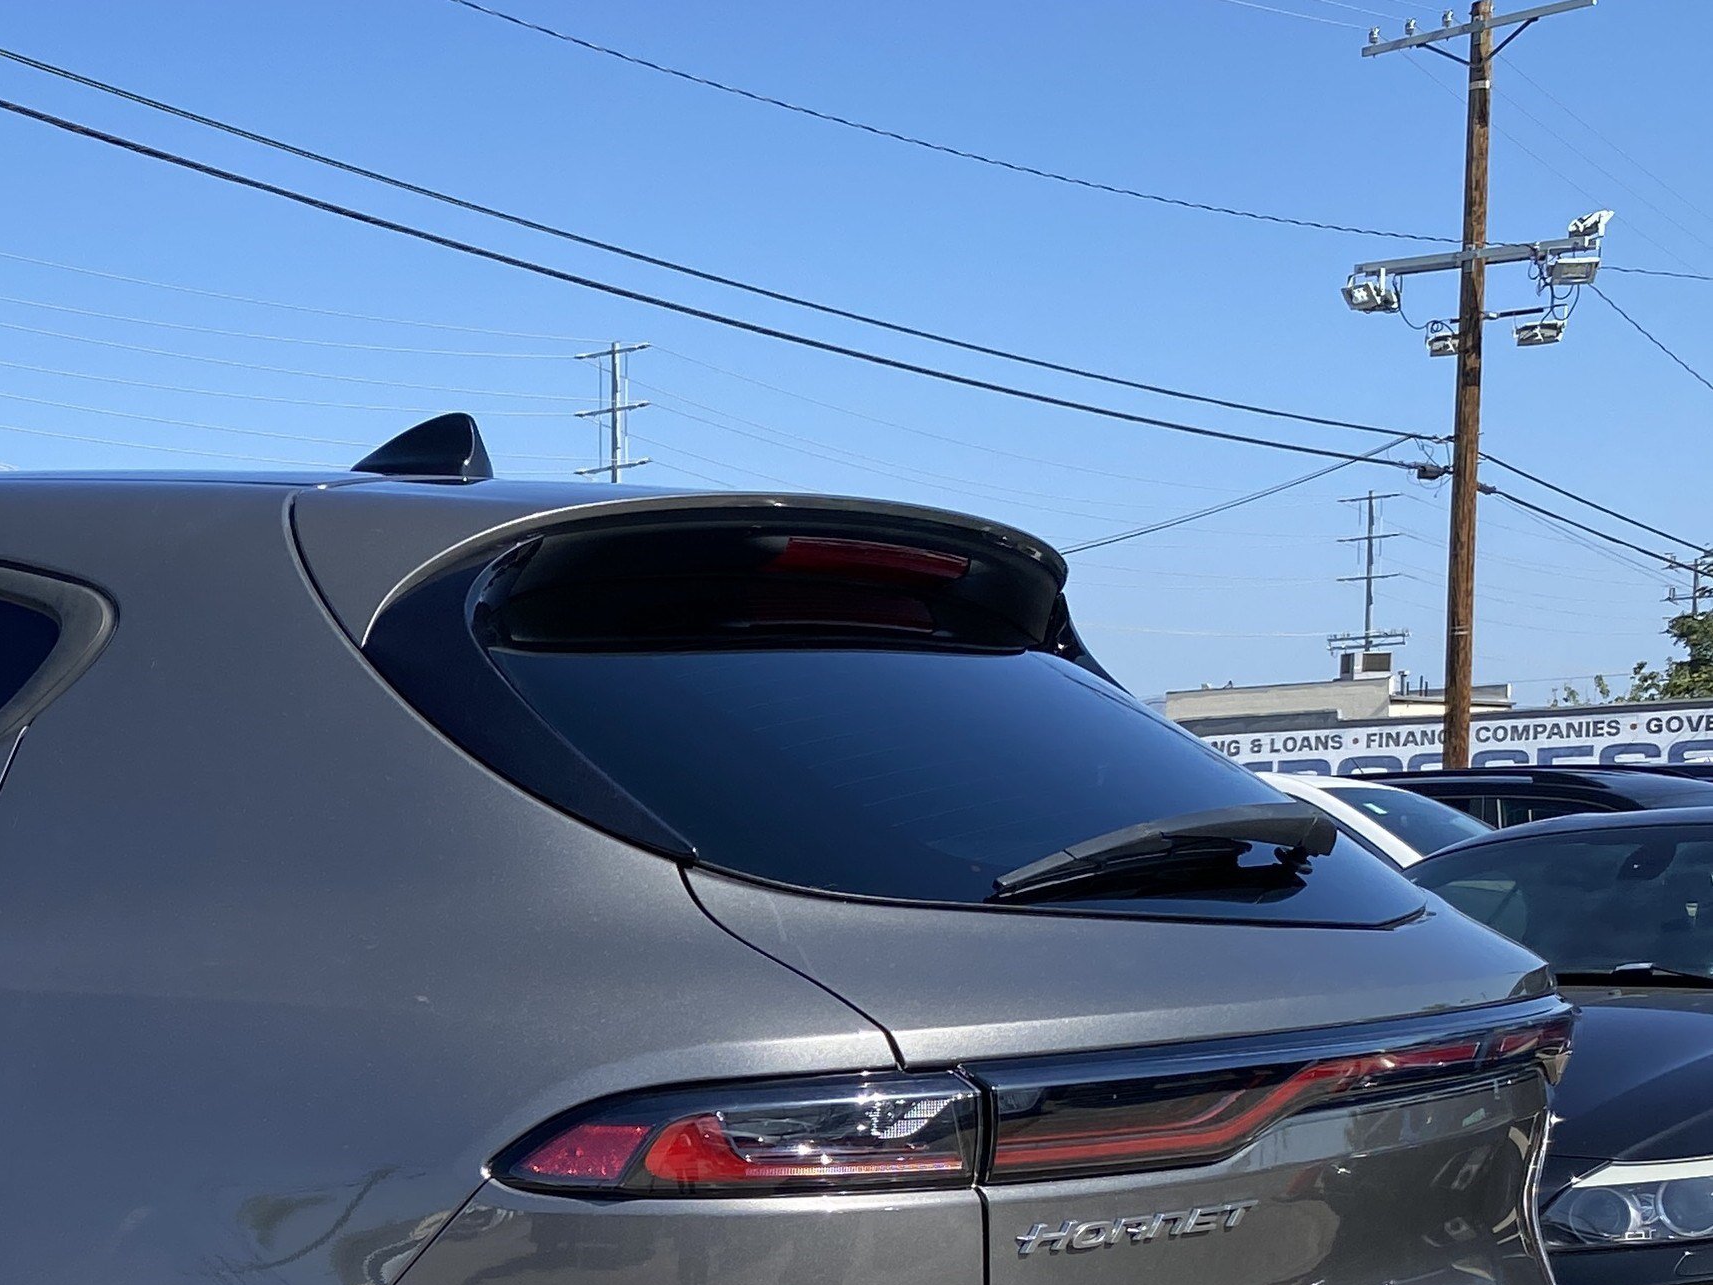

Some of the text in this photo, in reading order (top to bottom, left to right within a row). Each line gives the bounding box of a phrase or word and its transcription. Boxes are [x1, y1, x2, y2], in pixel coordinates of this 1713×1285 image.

[1249, 738, 1263, 754] &
[1269, 734, 1344, 754] LOANS
[1475, 719, 1621, 743] COMPANIES
[1015, 1199, 1259, 1256] HORNET
